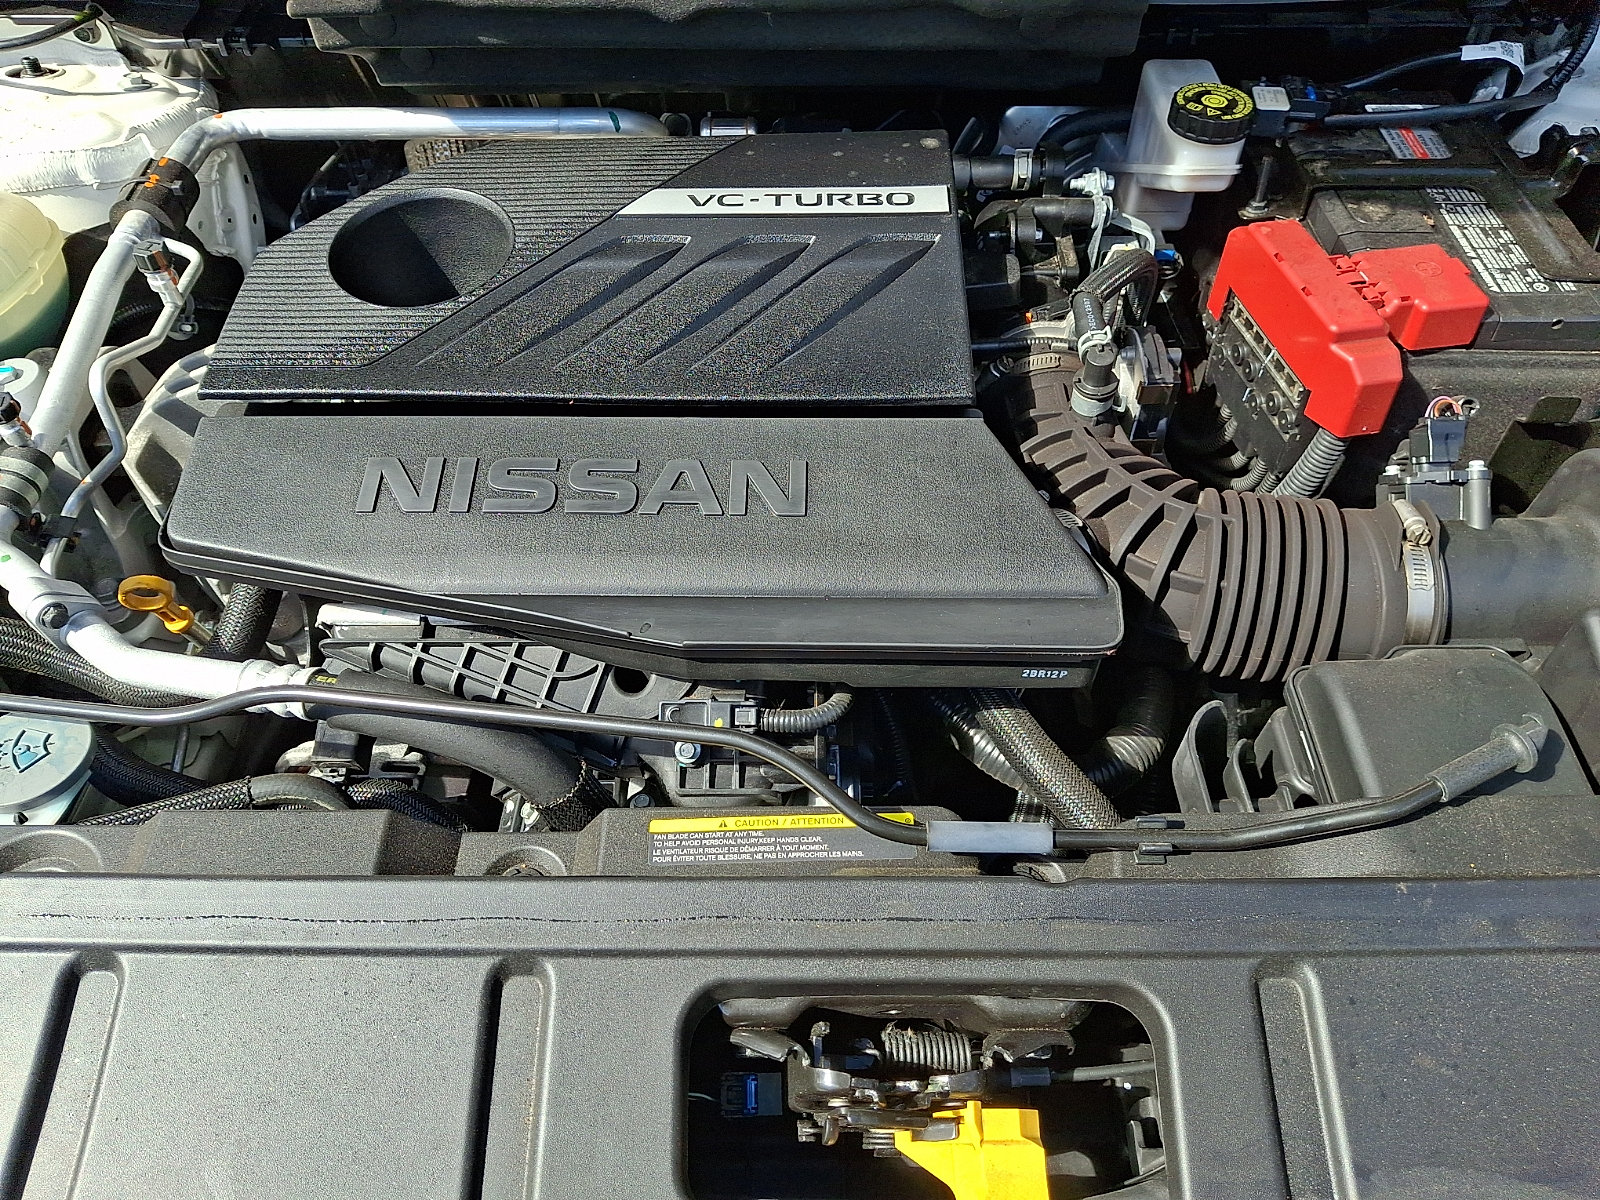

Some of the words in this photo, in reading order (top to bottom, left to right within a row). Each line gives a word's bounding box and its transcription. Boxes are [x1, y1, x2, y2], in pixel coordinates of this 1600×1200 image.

[686, 192, 916, 207] VC-TURBO
[355, 457, 808, 517] NISSAN
[1021, 669, 1068, 678] 2BR12P
[734, 818, 779, 828] CAUTION
[789, 817, 844, 826] ATTENTION
[662, 847, 703, 855] VENTILATEUR
[740, 844, 775, 853] DÉMARRER
[673, 854, 694, 862] ÉVITER
